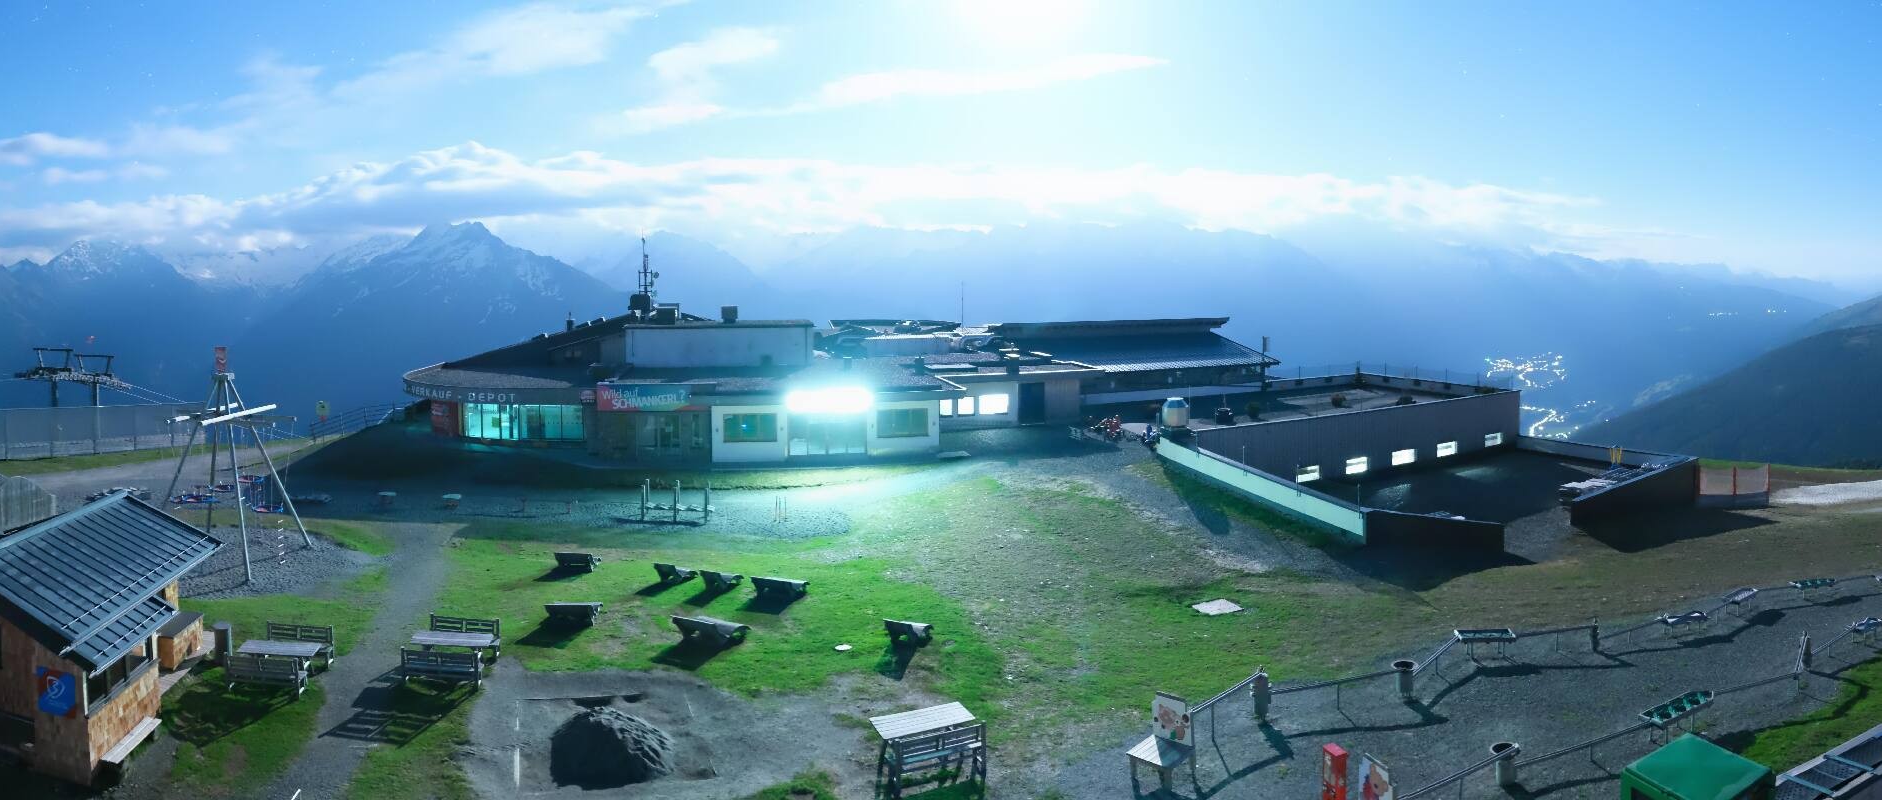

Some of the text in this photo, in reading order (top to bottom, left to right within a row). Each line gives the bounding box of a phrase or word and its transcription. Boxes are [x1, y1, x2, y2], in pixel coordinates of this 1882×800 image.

[411, 386, 452, 399] VERKAUF
[468, 392, 516, 402] DEPOT
[601, 386, 638, 400] Wild auf
